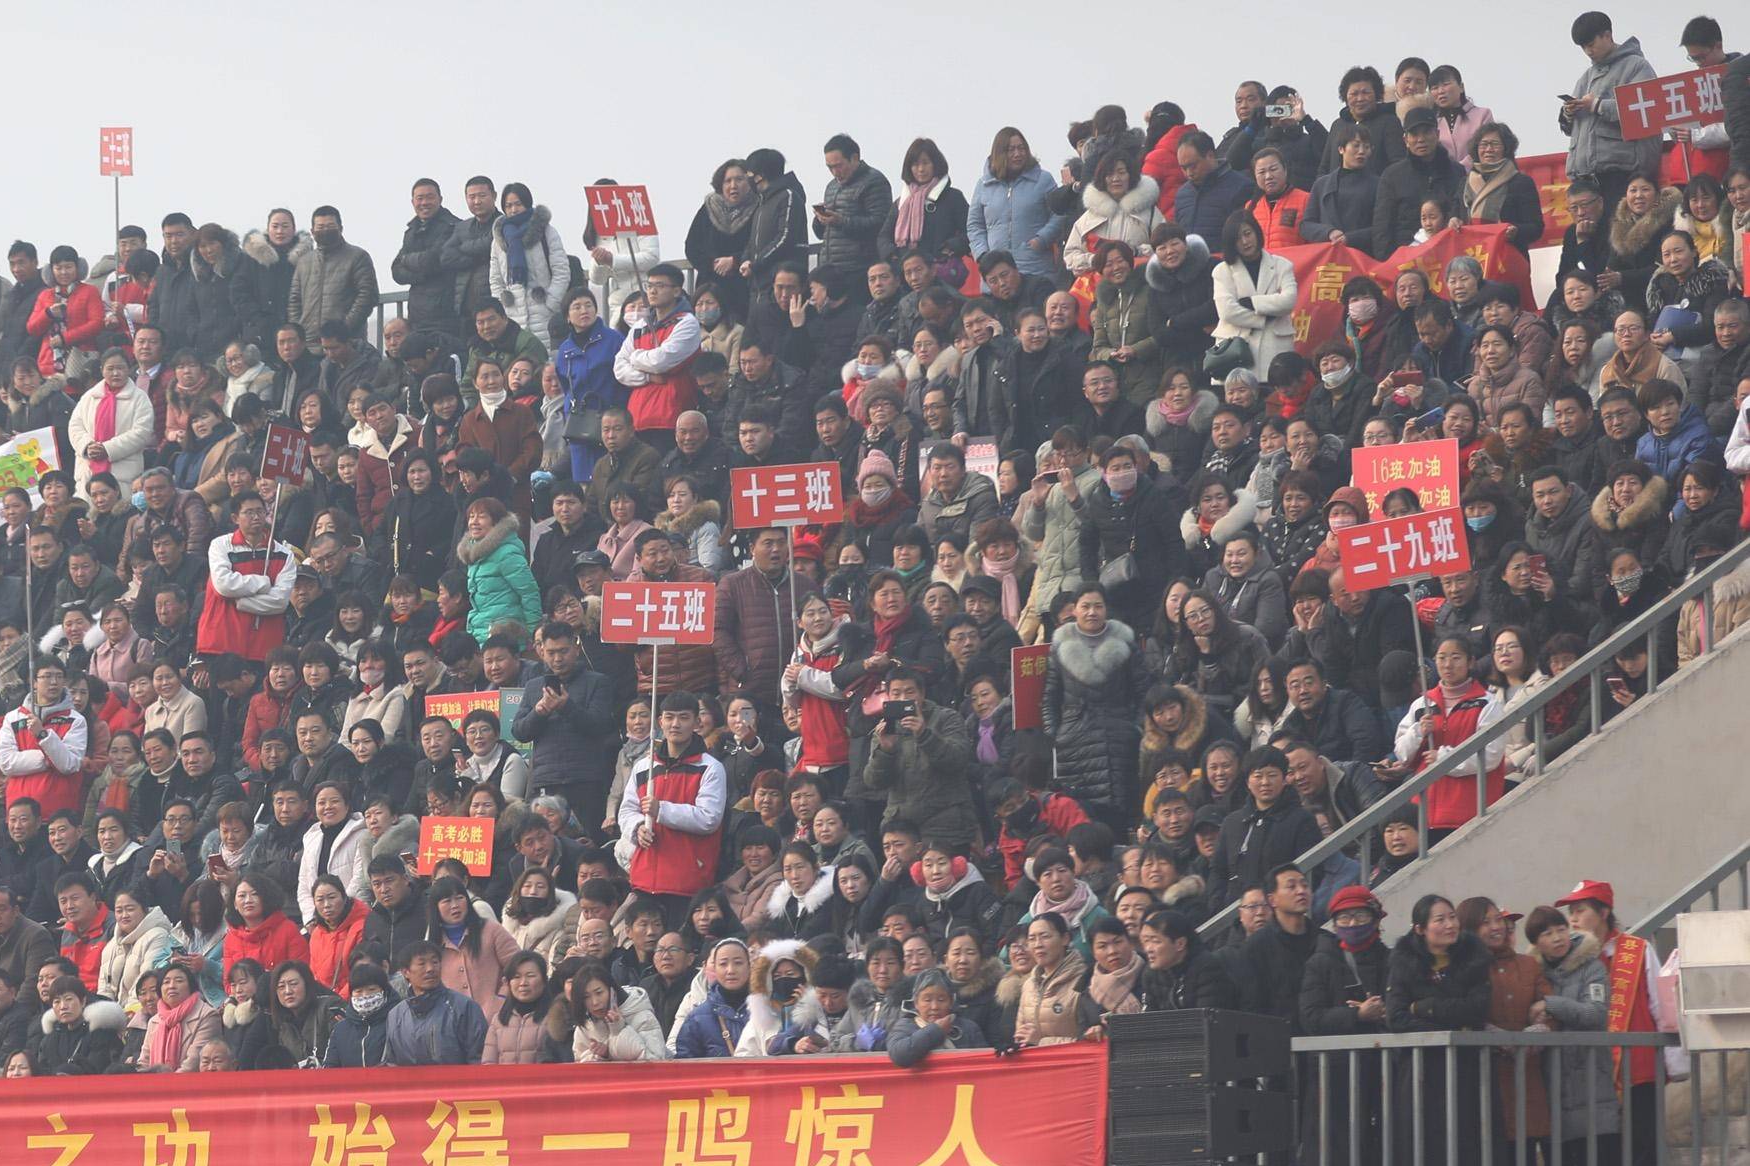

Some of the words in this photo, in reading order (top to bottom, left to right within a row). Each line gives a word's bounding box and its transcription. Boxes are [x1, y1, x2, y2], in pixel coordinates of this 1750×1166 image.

[1628, 72, 1725, 129] 十五班
[594, 189, 651, 228] 十九班
[267, 434, 307, 476] 二十班
[1371, 454, 1442, 484] 16班加油
[742, 468, 835, 517] 十三班
[1351, 517, 1460, 574] 二十九班
[611, 588, 706, 633] 二十五班
[432, 824, 484, 844] 高考必胜
